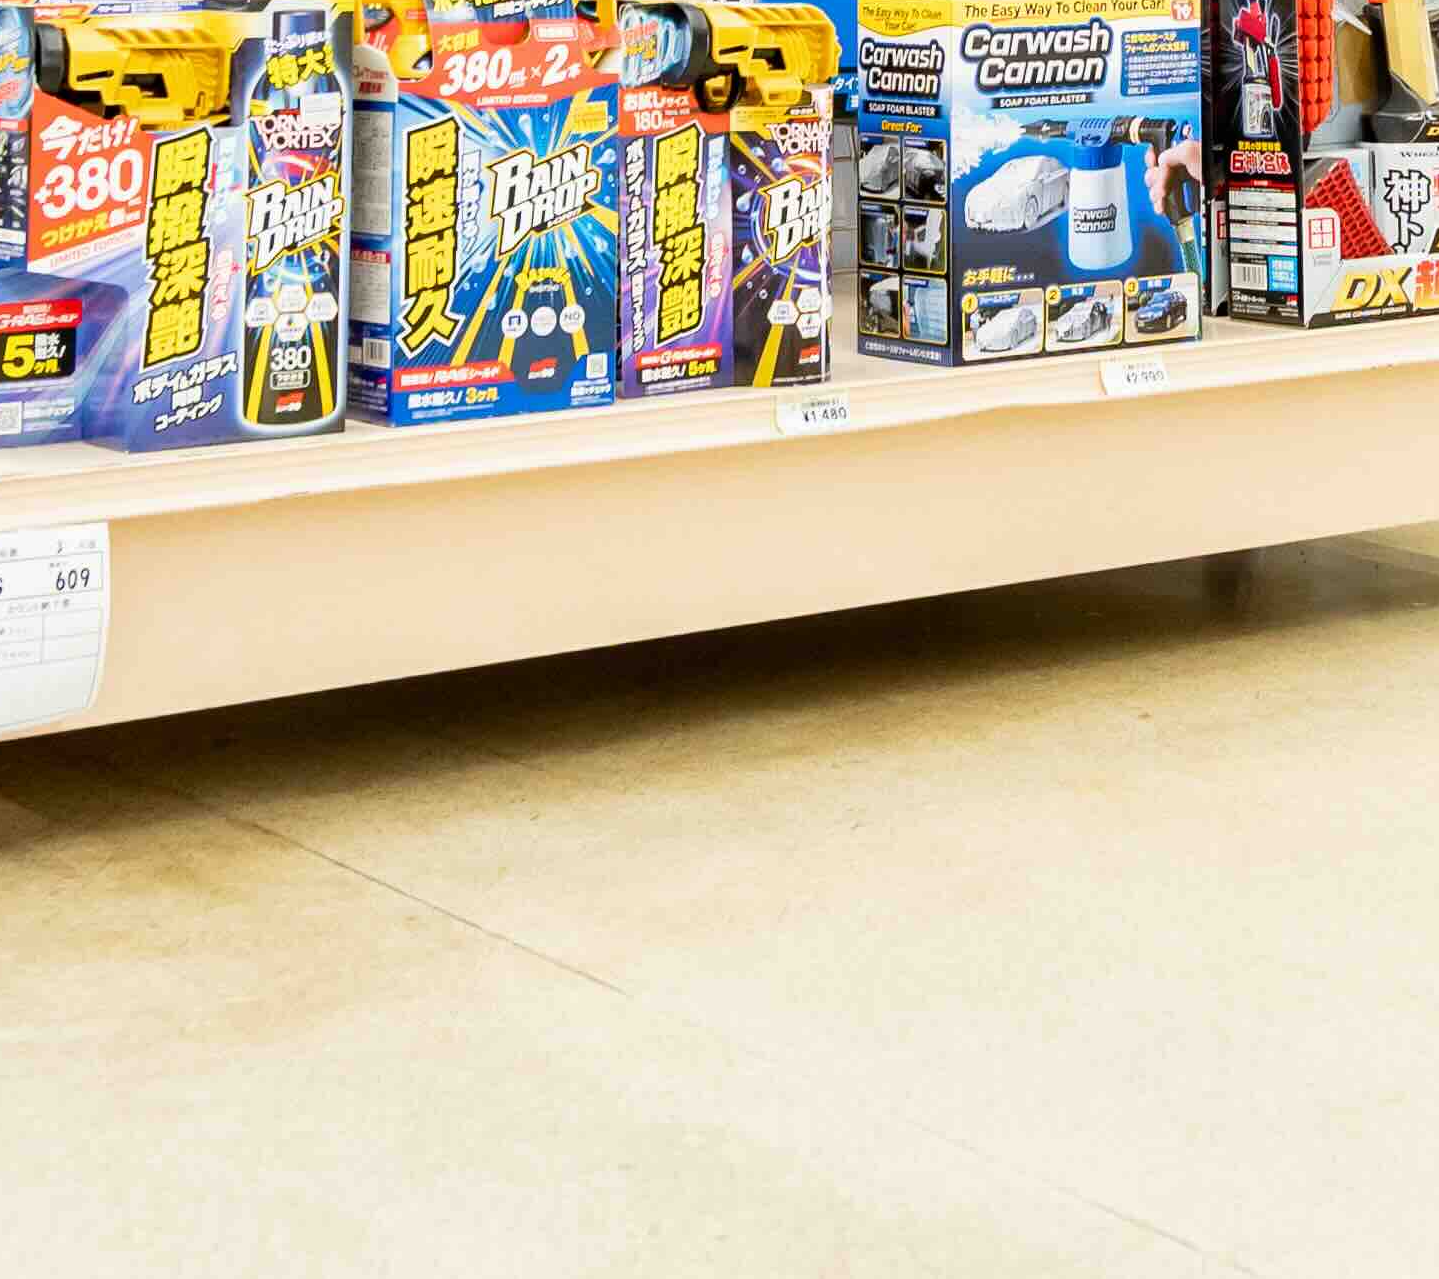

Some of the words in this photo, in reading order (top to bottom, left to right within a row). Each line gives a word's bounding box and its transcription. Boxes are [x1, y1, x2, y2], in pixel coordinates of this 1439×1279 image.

[963, 20, 1110, 55] Carwash
[861, 40, 944, 70] Carwash
[869, 69, 939, 95] Cannon
[979, 57, 1104, 86] Cannon
